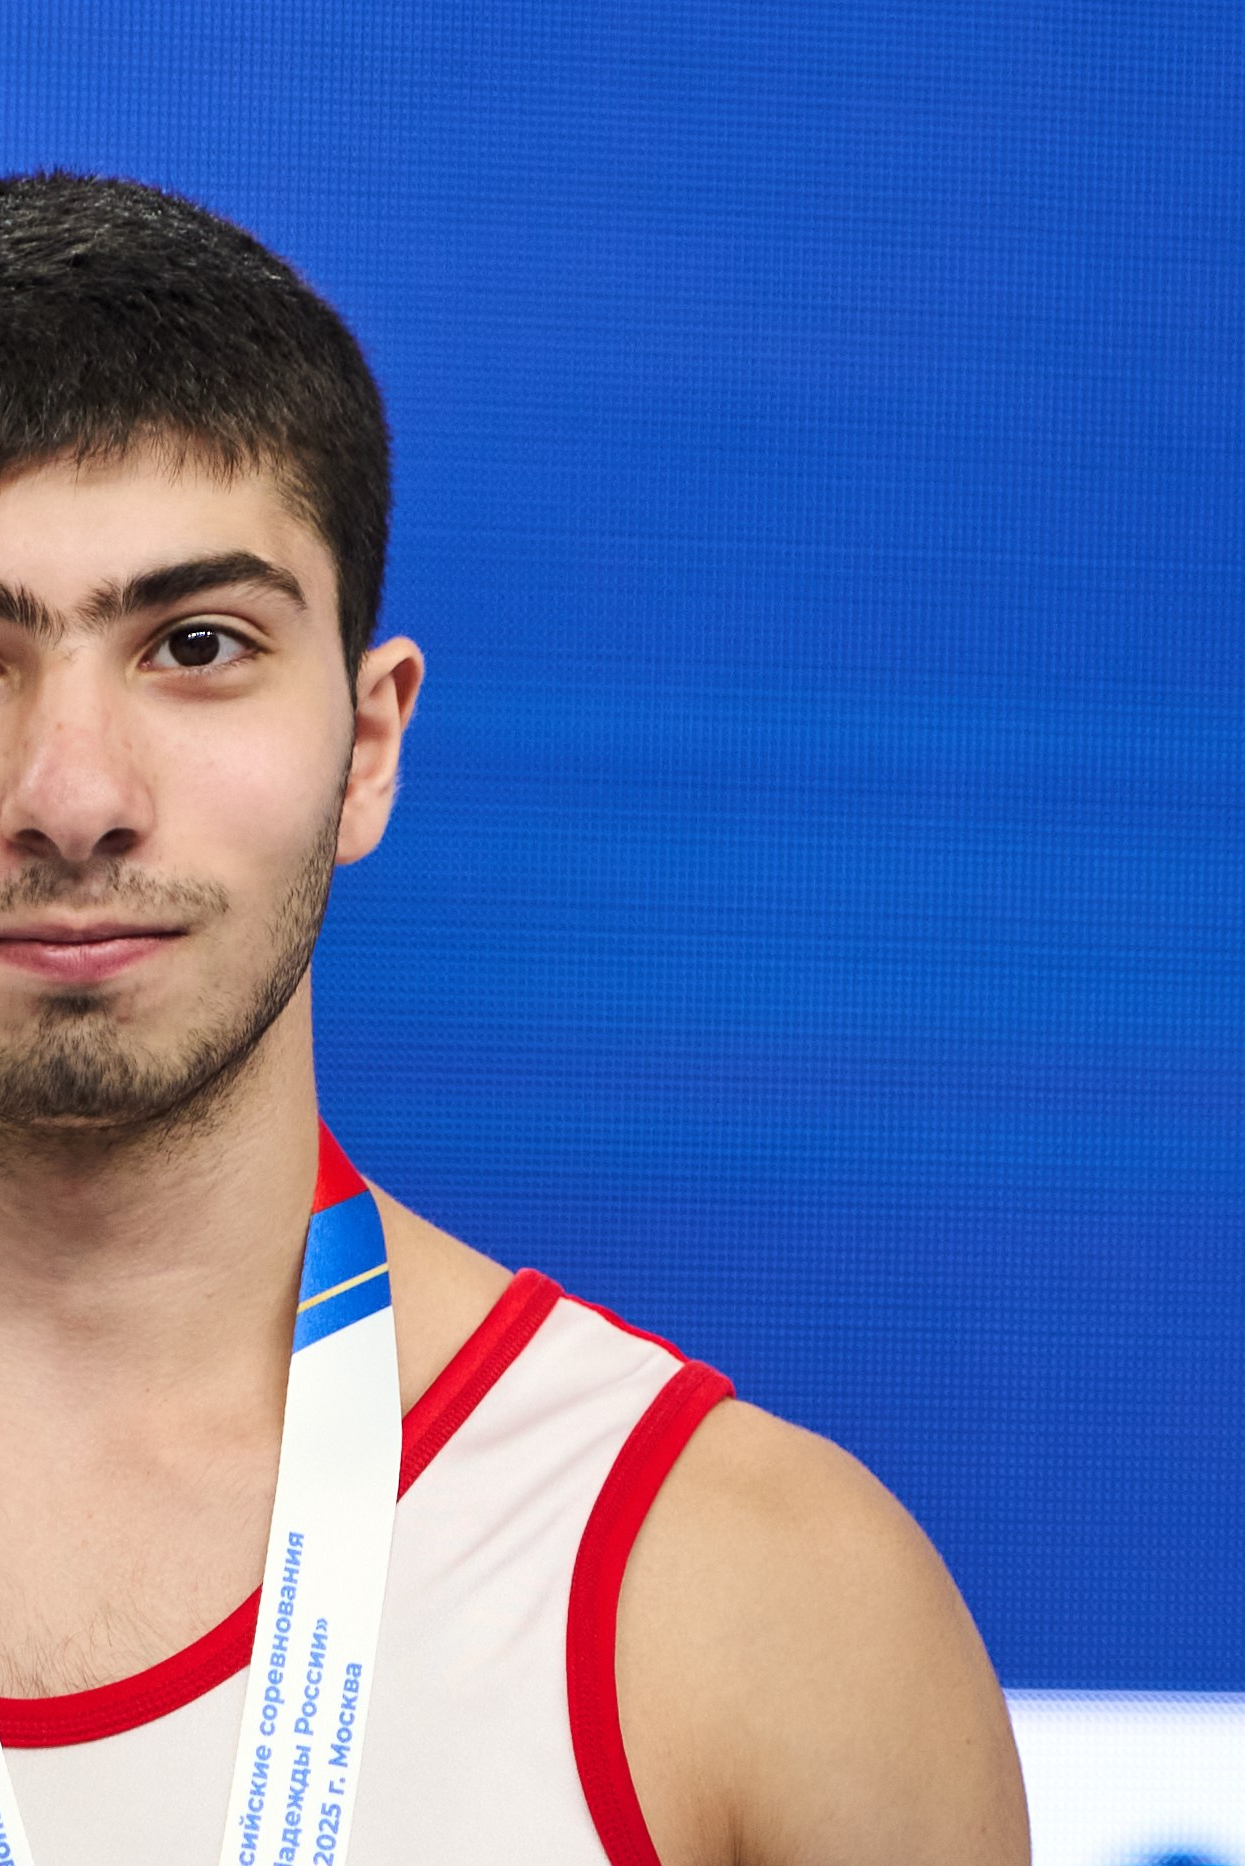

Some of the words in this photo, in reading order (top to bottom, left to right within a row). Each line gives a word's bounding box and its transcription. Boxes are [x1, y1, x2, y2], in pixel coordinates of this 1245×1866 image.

[259, 1531, 305, 1738] соревнования
[294, 1617, 329, 1737] России»
[329, 1662, 363, 1768] Москва
[329, 1777, 345, 1797] г.
